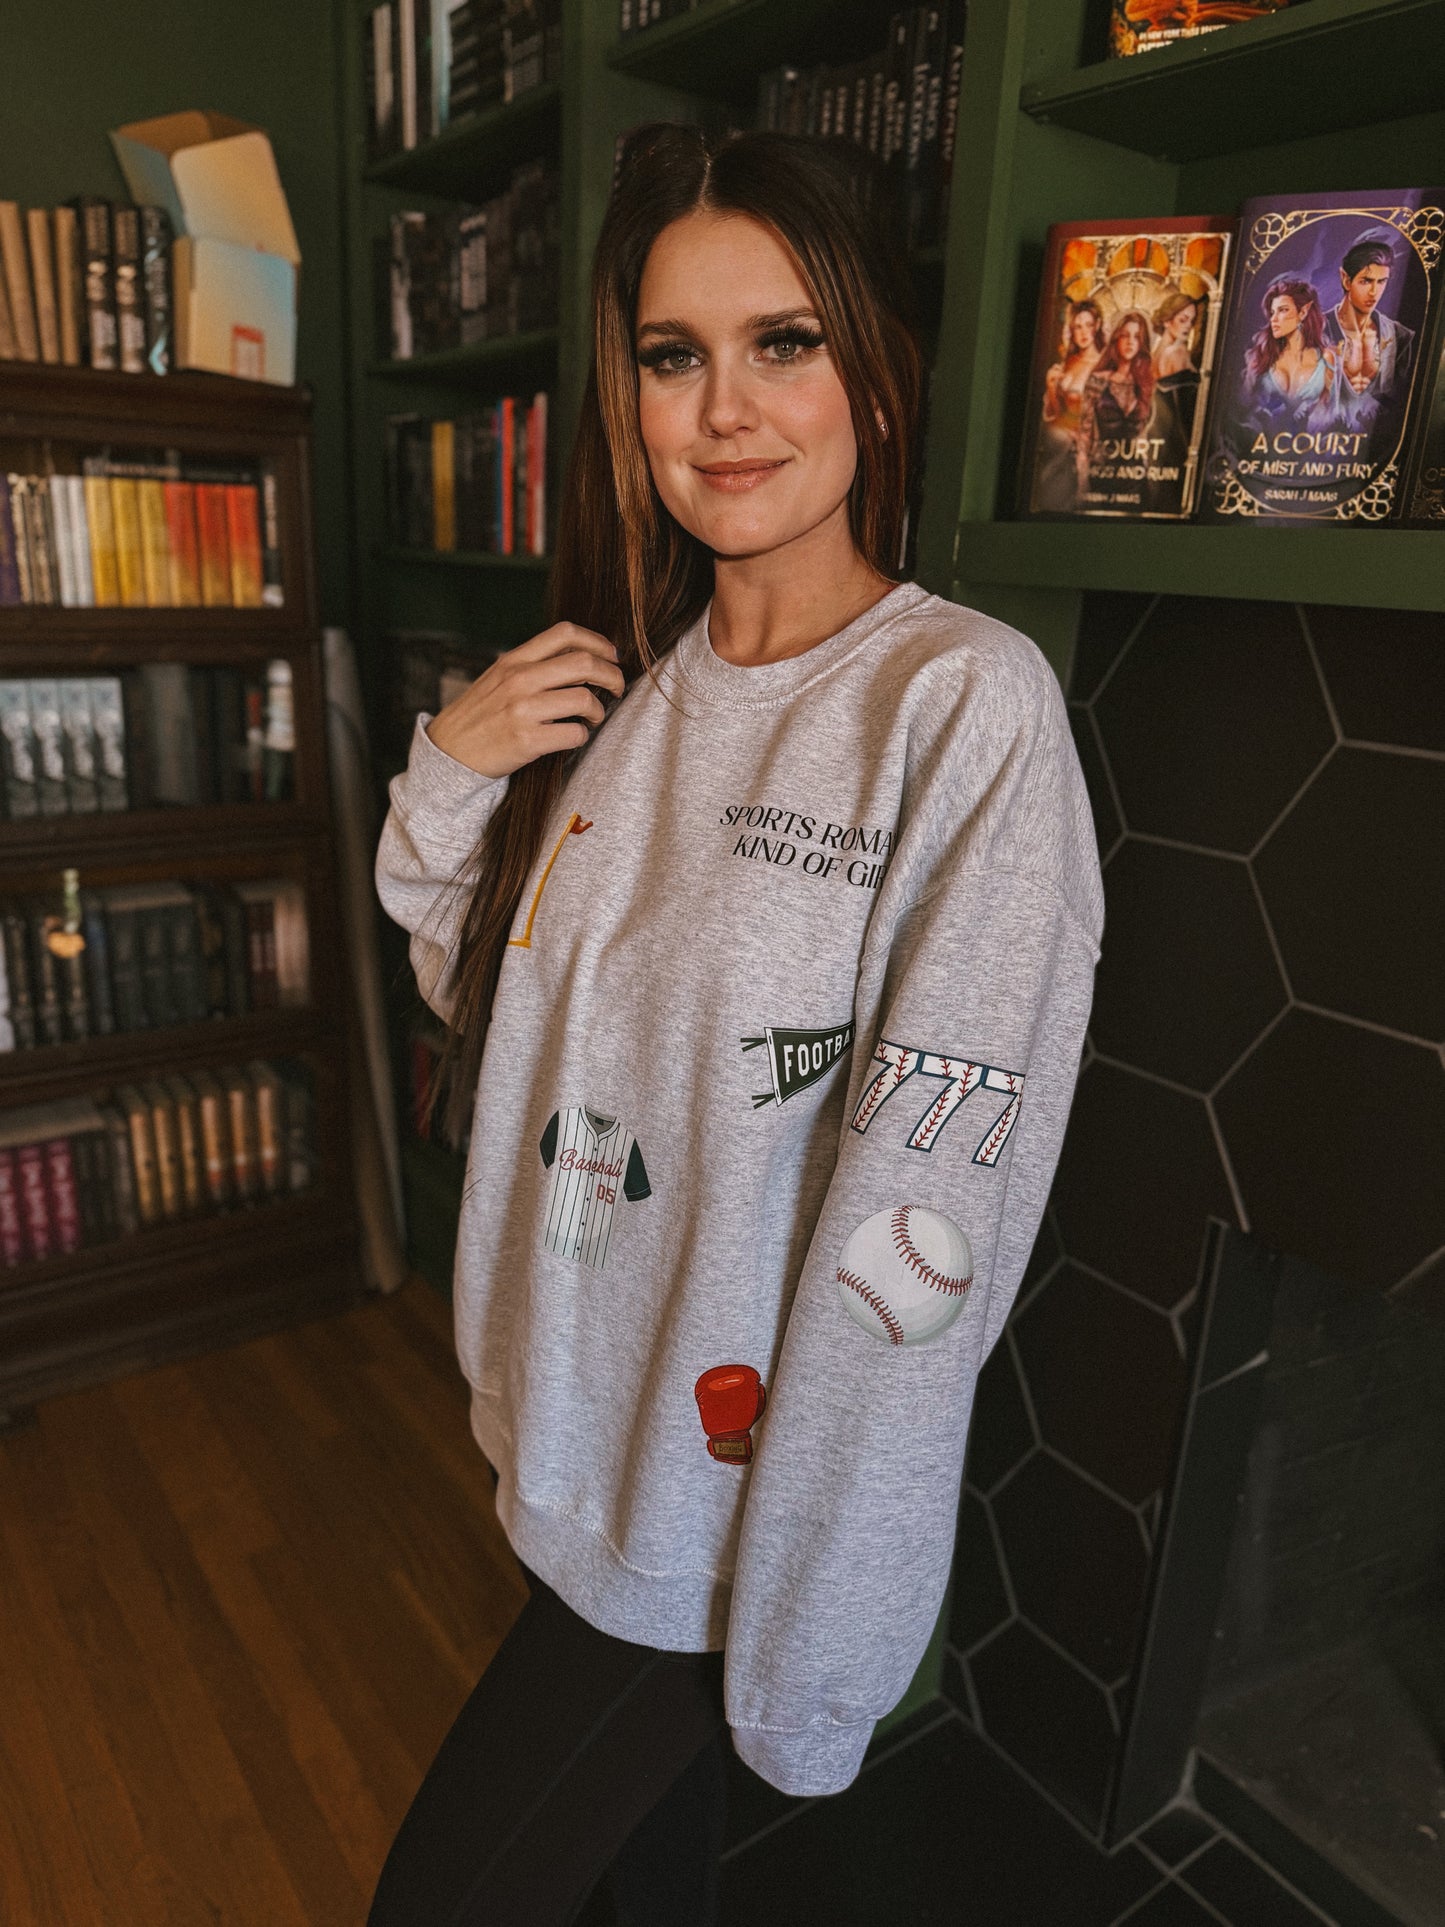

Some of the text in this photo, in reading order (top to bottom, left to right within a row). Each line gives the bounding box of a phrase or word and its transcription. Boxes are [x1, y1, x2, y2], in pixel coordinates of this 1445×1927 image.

[1100, 438, 1165, 461] OURT
[1250, 431, 1368, 456] A COURT
[1116, 465, 1146, 481] AND
[1147, 466, 1179, 482] RUIN
[1237, 459, 1379, 480] OF MIST AND FURY
[1263, 488, 1338, 502] SARAH J MAAS
[719, 805, 817, 840] SPORTS
[732, 835, 797, 866] KIND
[802, 851, 844, 879] OF
[559, 1148, 624, 1178] Baseball
[596, 1184, 616, 1205] 05
